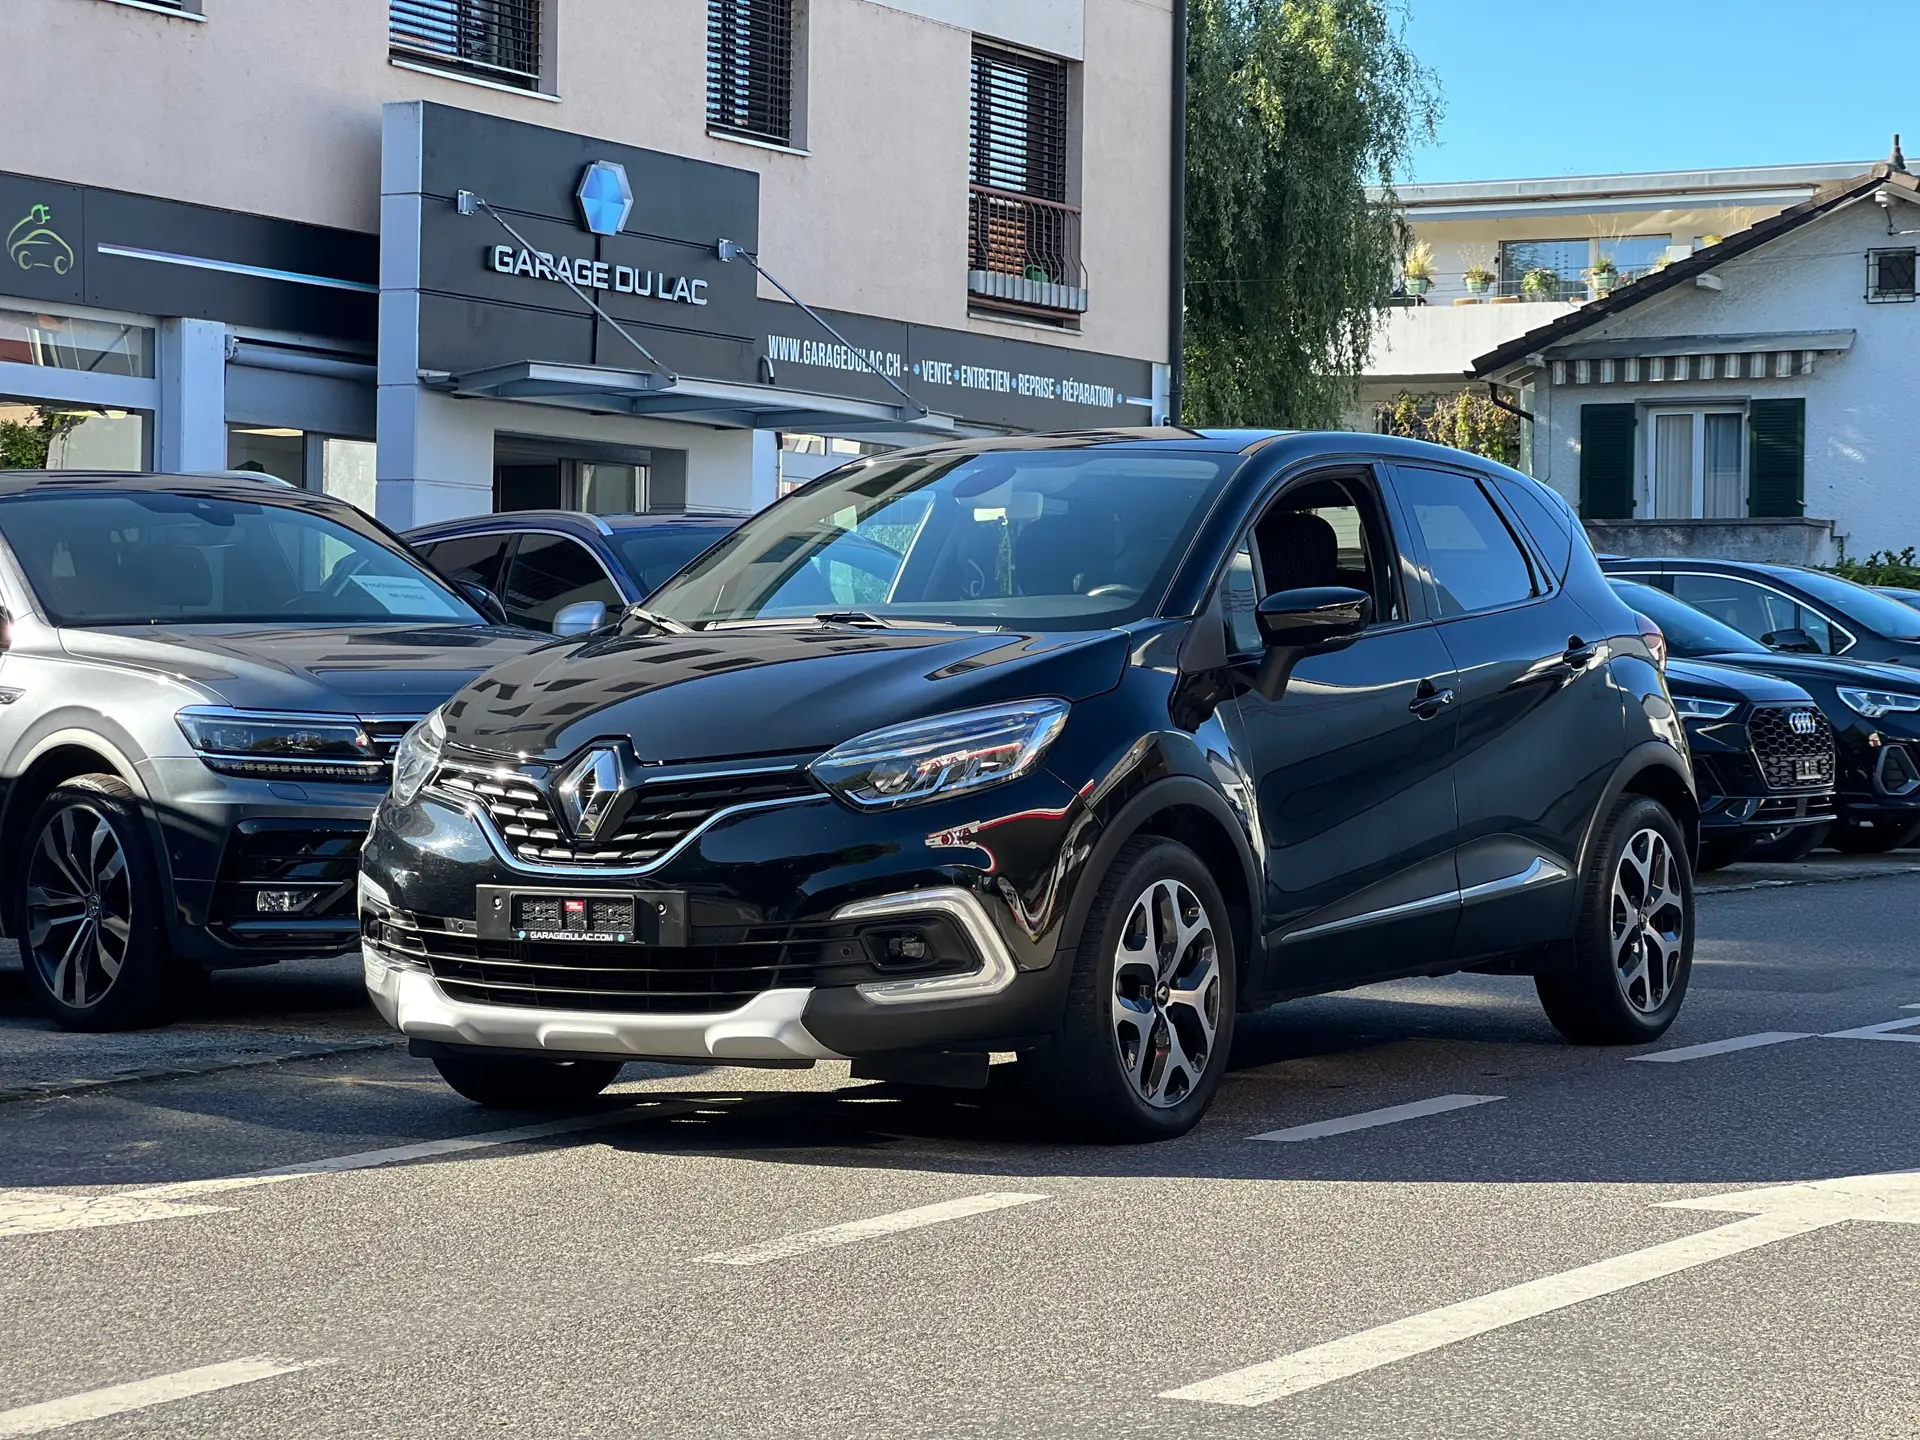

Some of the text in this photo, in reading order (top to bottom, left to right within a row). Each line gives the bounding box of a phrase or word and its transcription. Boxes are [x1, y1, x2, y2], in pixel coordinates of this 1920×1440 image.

[494, 245, 708, 306] GARAGE DU LAC
[768, 334, 1114, 408] WWW.GARAGEDULAC.CH VENTE ENTRETIEN REPRISE RÉPARATION
